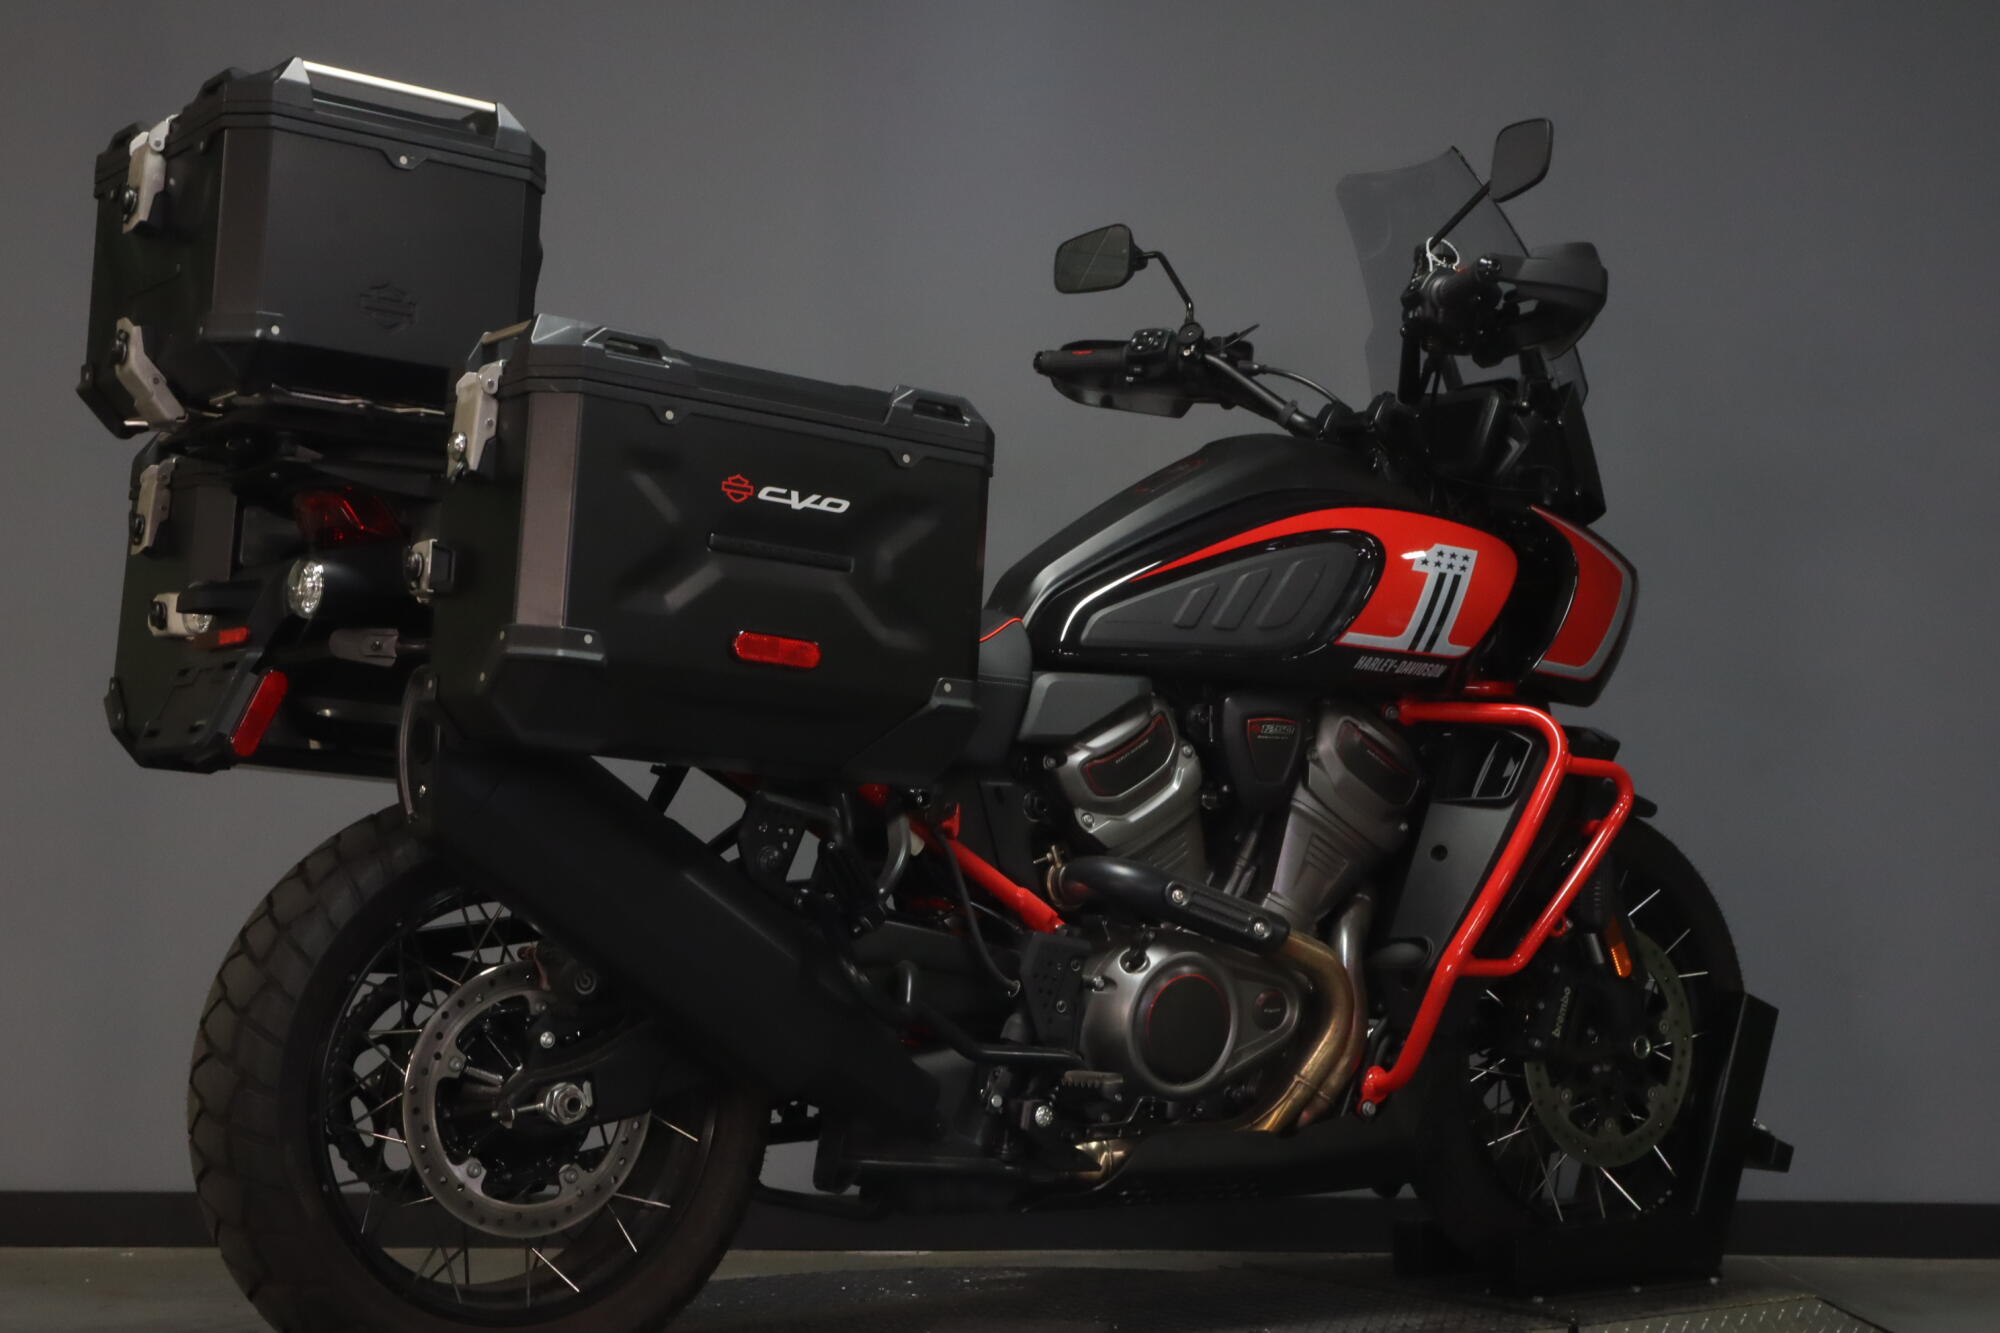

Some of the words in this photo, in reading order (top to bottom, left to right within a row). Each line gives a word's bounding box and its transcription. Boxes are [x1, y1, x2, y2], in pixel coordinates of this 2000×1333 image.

[757, 486, 851, 514] CVO
[1353, 655, 1448, 678] HARLEY-DAVIDSON
[1551, 985, 1572, 1038] brembo
